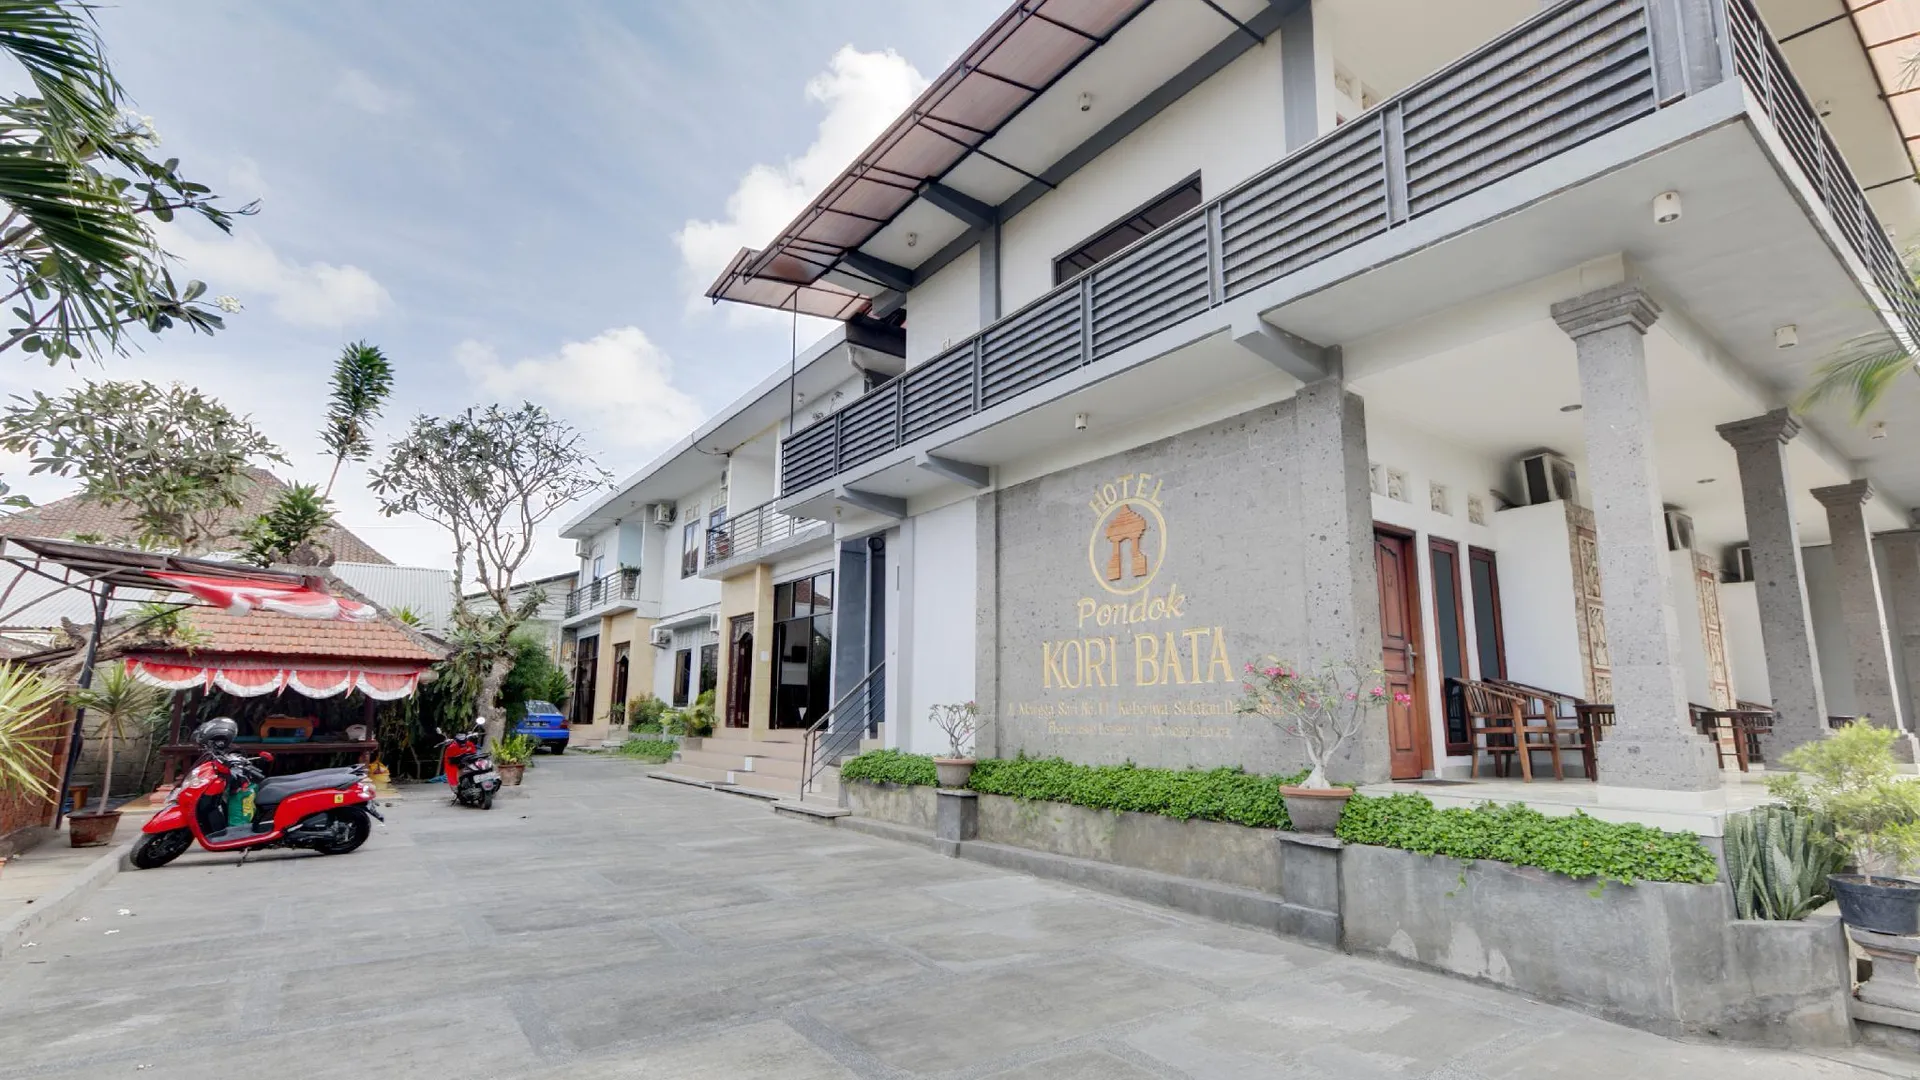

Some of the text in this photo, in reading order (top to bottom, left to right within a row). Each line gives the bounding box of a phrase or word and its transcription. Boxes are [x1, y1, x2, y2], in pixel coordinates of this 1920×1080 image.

[1089, 473, 1163, 517] HOTEL
[1077, 583, 1185, 627] Pondok
[1043, 626, 1234, 689] KORI BATA
